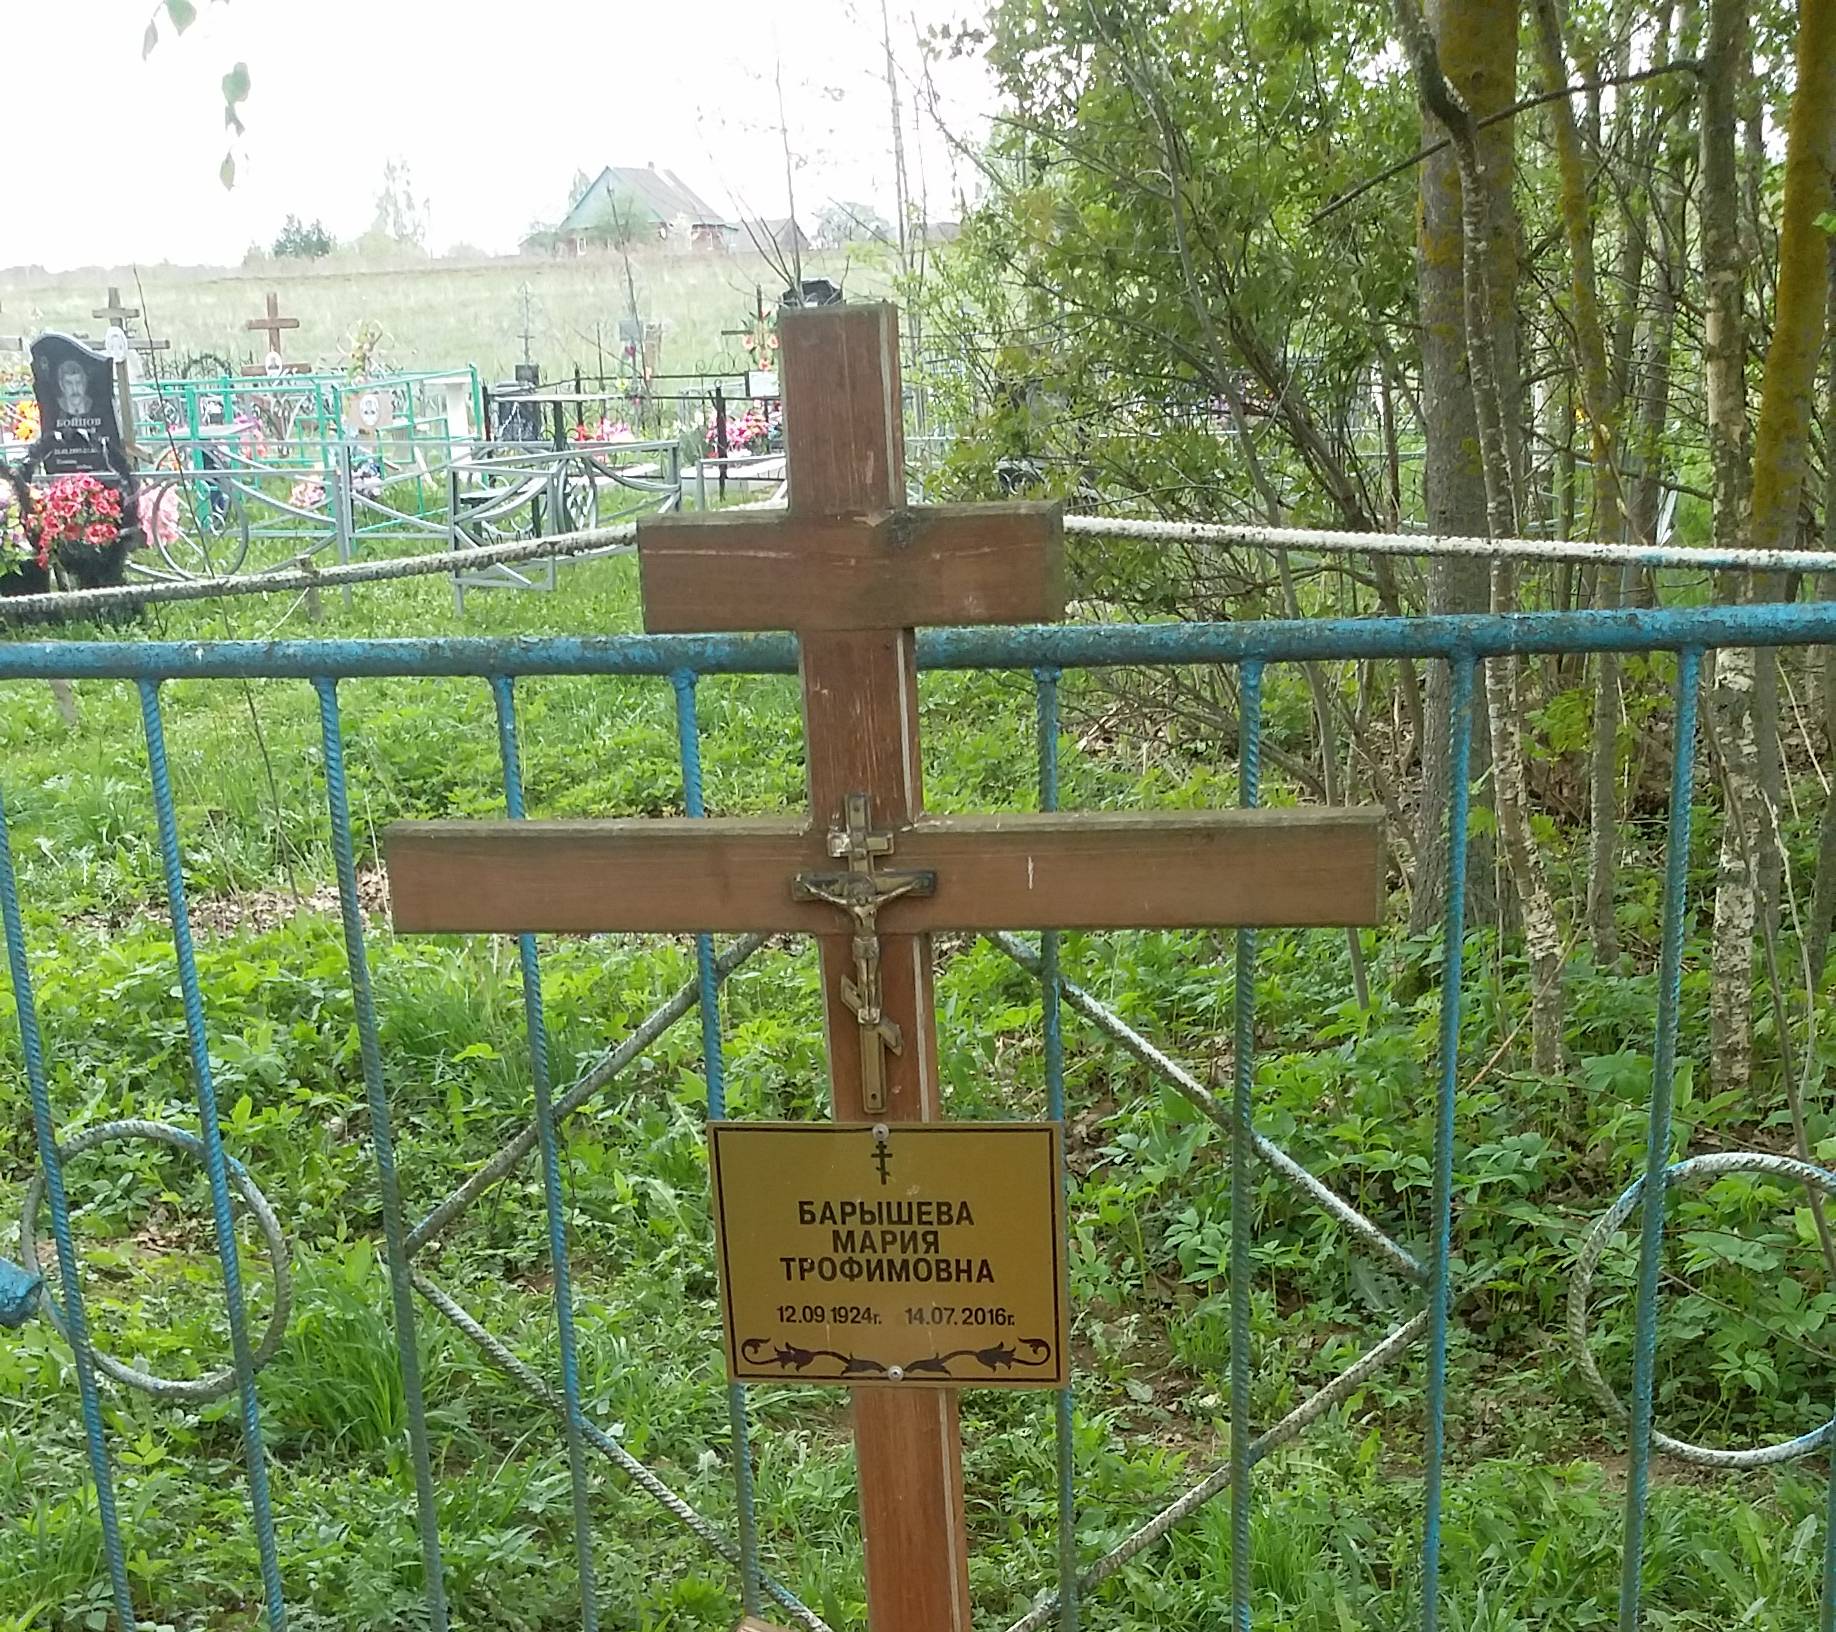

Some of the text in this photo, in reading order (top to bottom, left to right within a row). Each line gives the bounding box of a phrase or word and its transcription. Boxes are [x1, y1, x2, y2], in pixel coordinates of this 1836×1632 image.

[797, 1200, 975, 1226] БАРЫШЕВА
[831, 1229, 940, 1254] МАРИЯ
[779, 1256, 995, 1284] ТРОФИМОВНА
